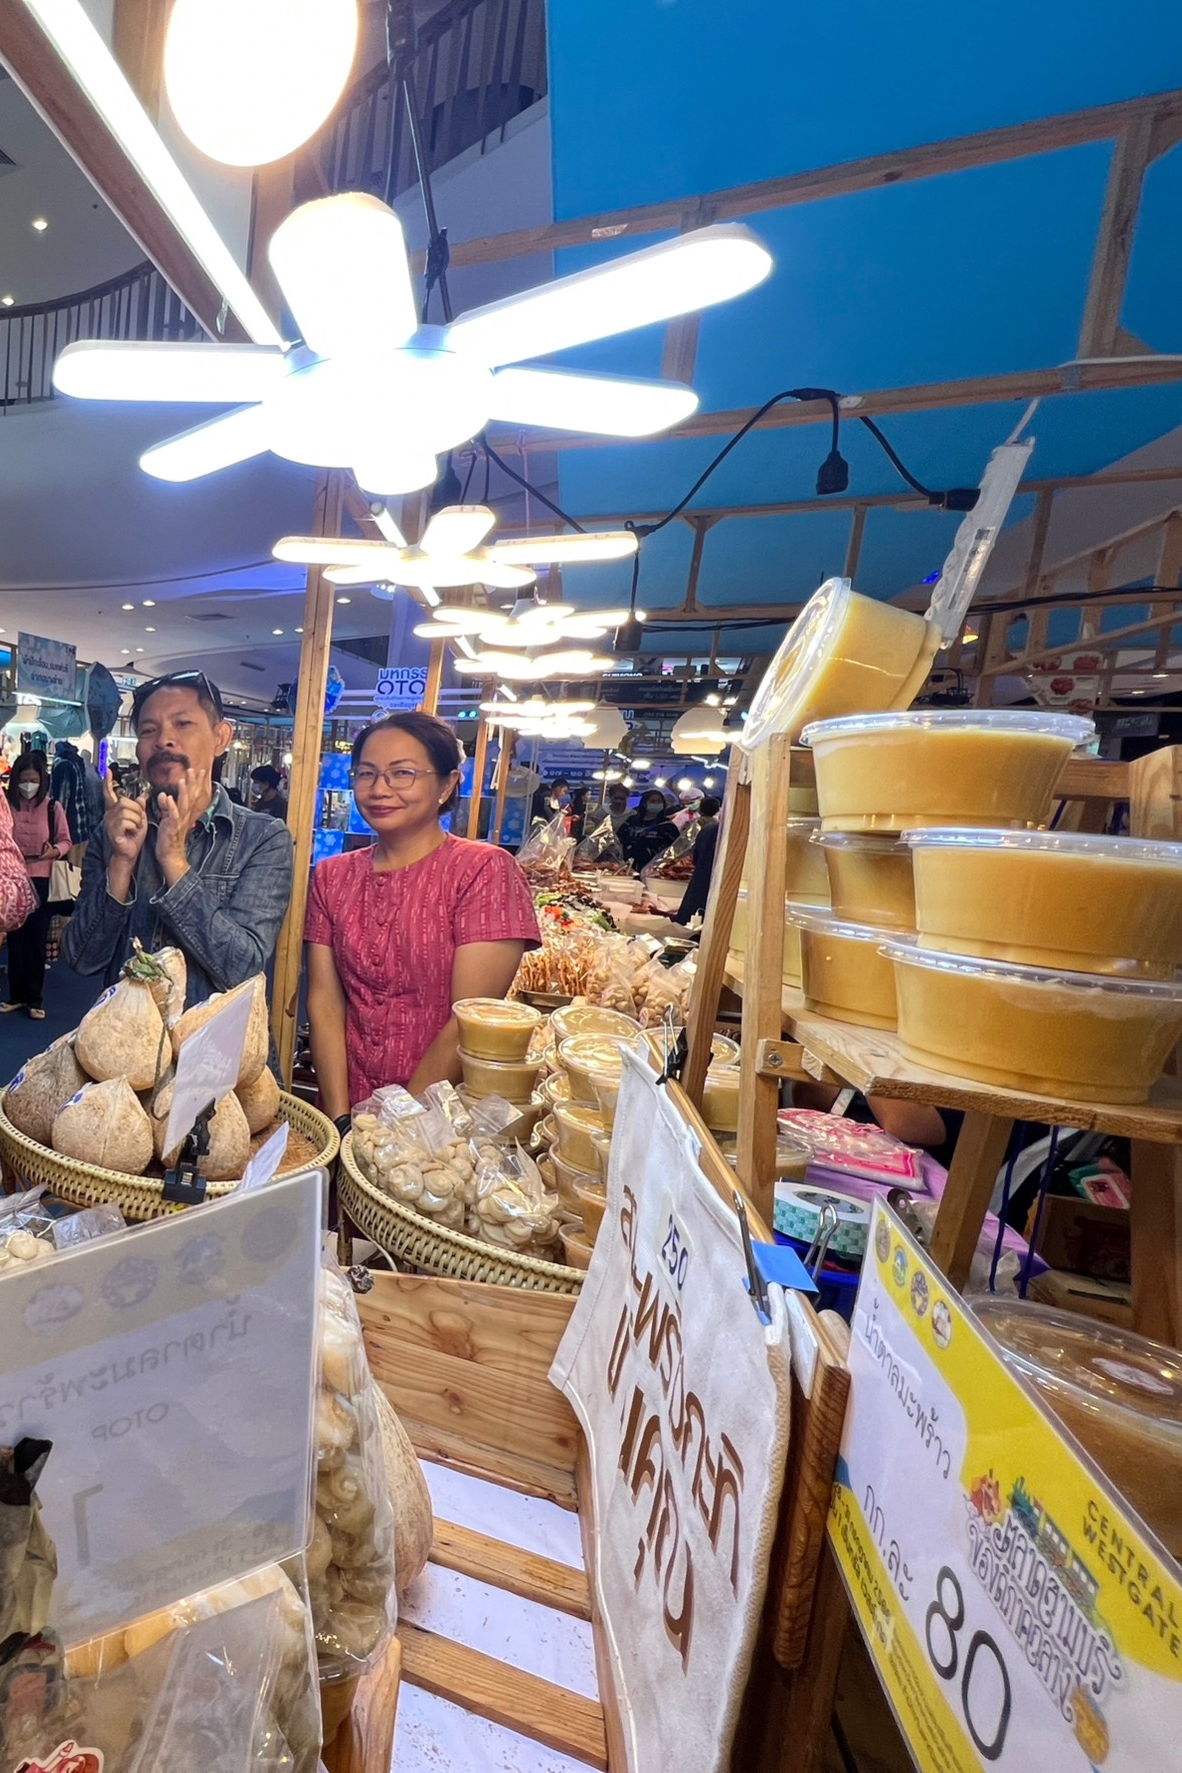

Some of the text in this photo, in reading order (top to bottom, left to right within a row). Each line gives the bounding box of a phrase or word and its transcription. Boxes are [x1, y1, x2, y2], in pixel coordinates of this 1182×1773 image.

[377, 680, 426, 695] OTO
[379, 668, 428, 679] มหกรร
[661, 1213, 689, 1291] 250
[865, 1298, 951, 1479] น้ำตาลมะพร้าว
[863, 1484, 913, 1601] กก.ละ
[1082, 1516, 1181, 1658] WESTGATE
[1088, 1500, 1179, 1629] CENTRAL
[925, 1565, 1012, 1761] 80
